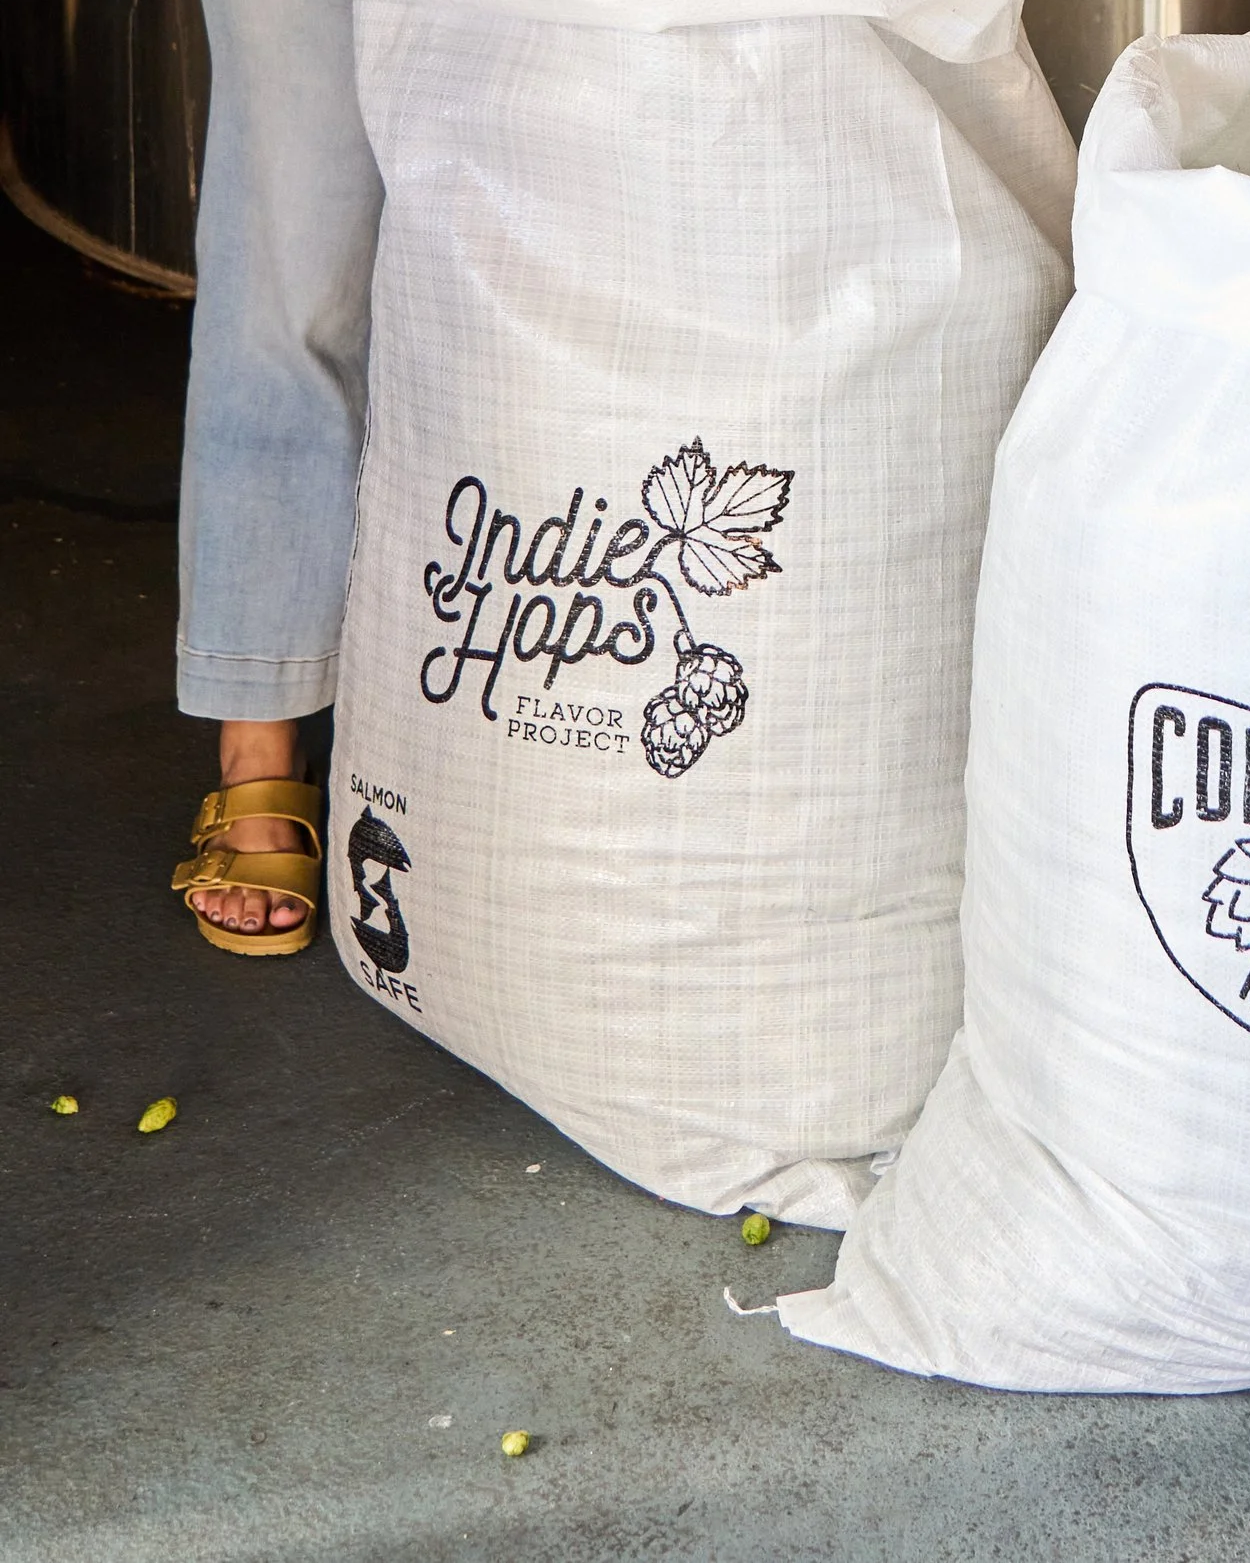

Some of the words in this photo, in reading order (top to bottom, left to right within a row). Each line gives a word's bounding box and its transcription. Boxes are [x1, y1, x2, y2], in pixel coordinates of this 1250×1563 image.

[424, 475, 655, 603] Indie
[420, 582, 658, 721] Hops
[507, 718, 630, 754] PROJECT
[515, 695, 623, 729] FLAVOR
[350, 773, 407, 815] SALMON
[360, 960, 423, 1014] SAFE
